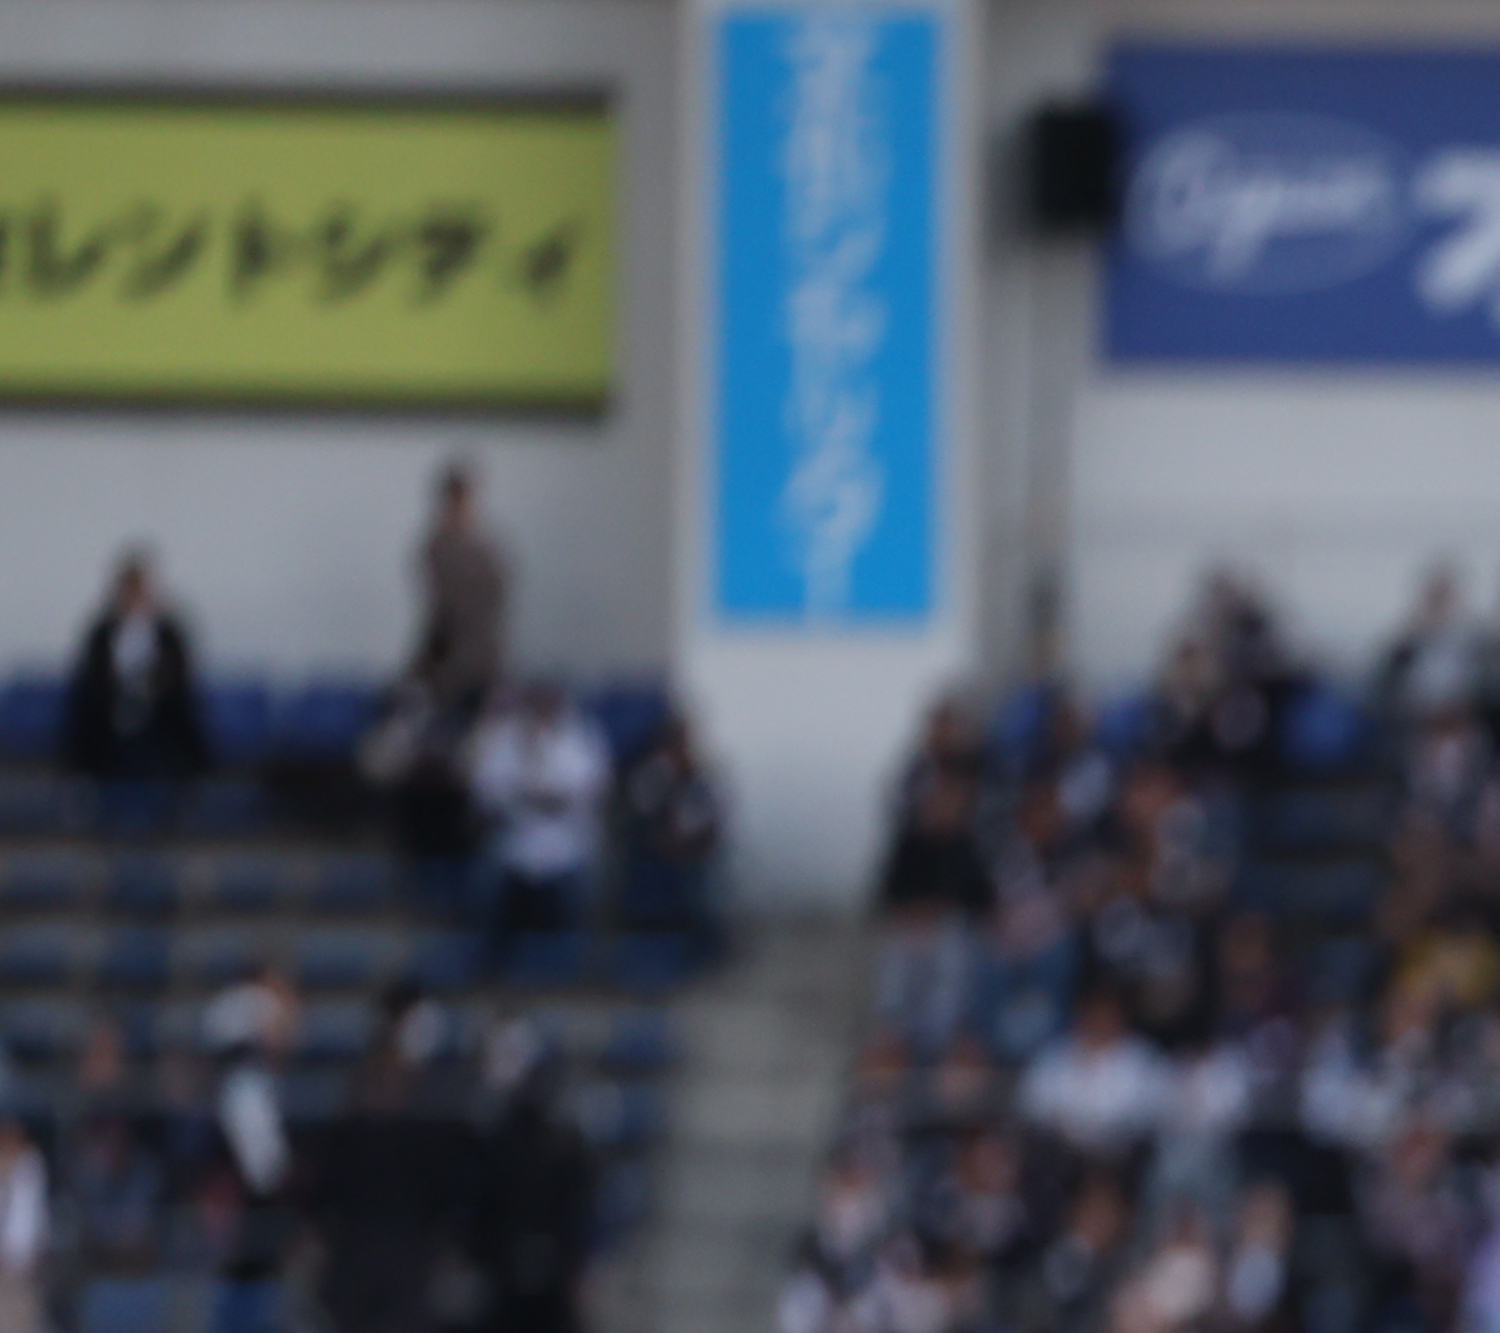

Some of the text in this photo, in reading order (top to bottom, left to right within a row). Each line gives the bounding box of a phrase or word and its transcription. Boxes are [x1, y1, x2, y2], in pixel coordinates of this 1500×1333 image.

[0, 195, 575, 305] レントシティ
